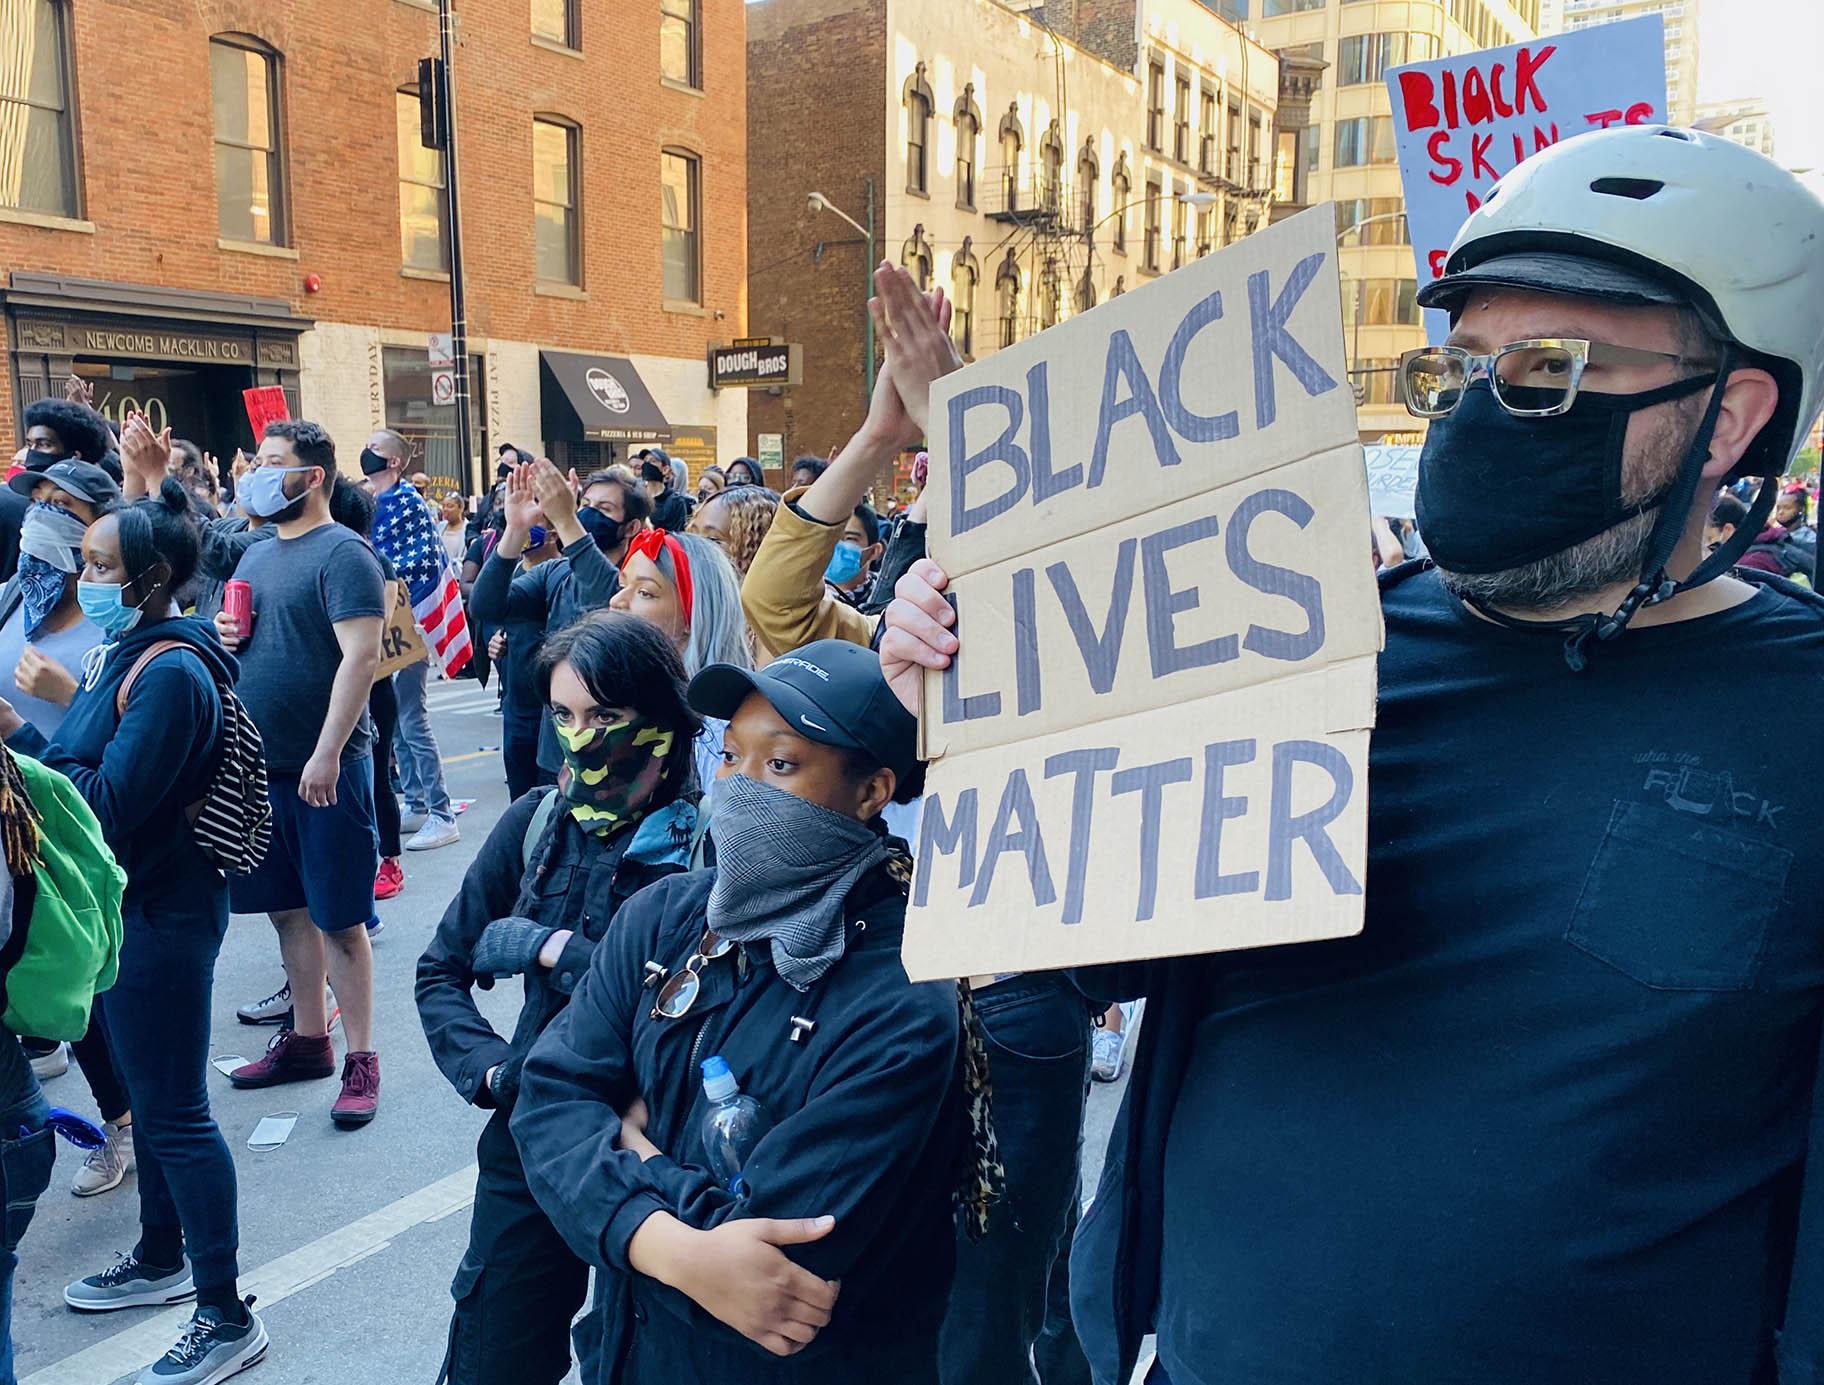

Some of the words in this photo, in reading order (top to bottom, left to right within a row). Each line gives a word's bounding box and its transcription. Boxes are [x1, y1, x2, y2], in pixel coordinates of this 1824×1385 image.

[86, 331, 154, 352] NEWCOMB
[160, 335, 217, 357] MACKLIN
[221, 342, 239, 358] CO
[368, 342, 381, 430] VERYDAY
[717, 351, 758, 374] DOUGH
[758, 355, 787, 375] BROS
[490, 390, 501, 438] PIZZA
[947, 252, 1338, 537] BLACK
[942, 489, 1325, 724] LIVES
[912, 738, 1362, 925] MATTER
